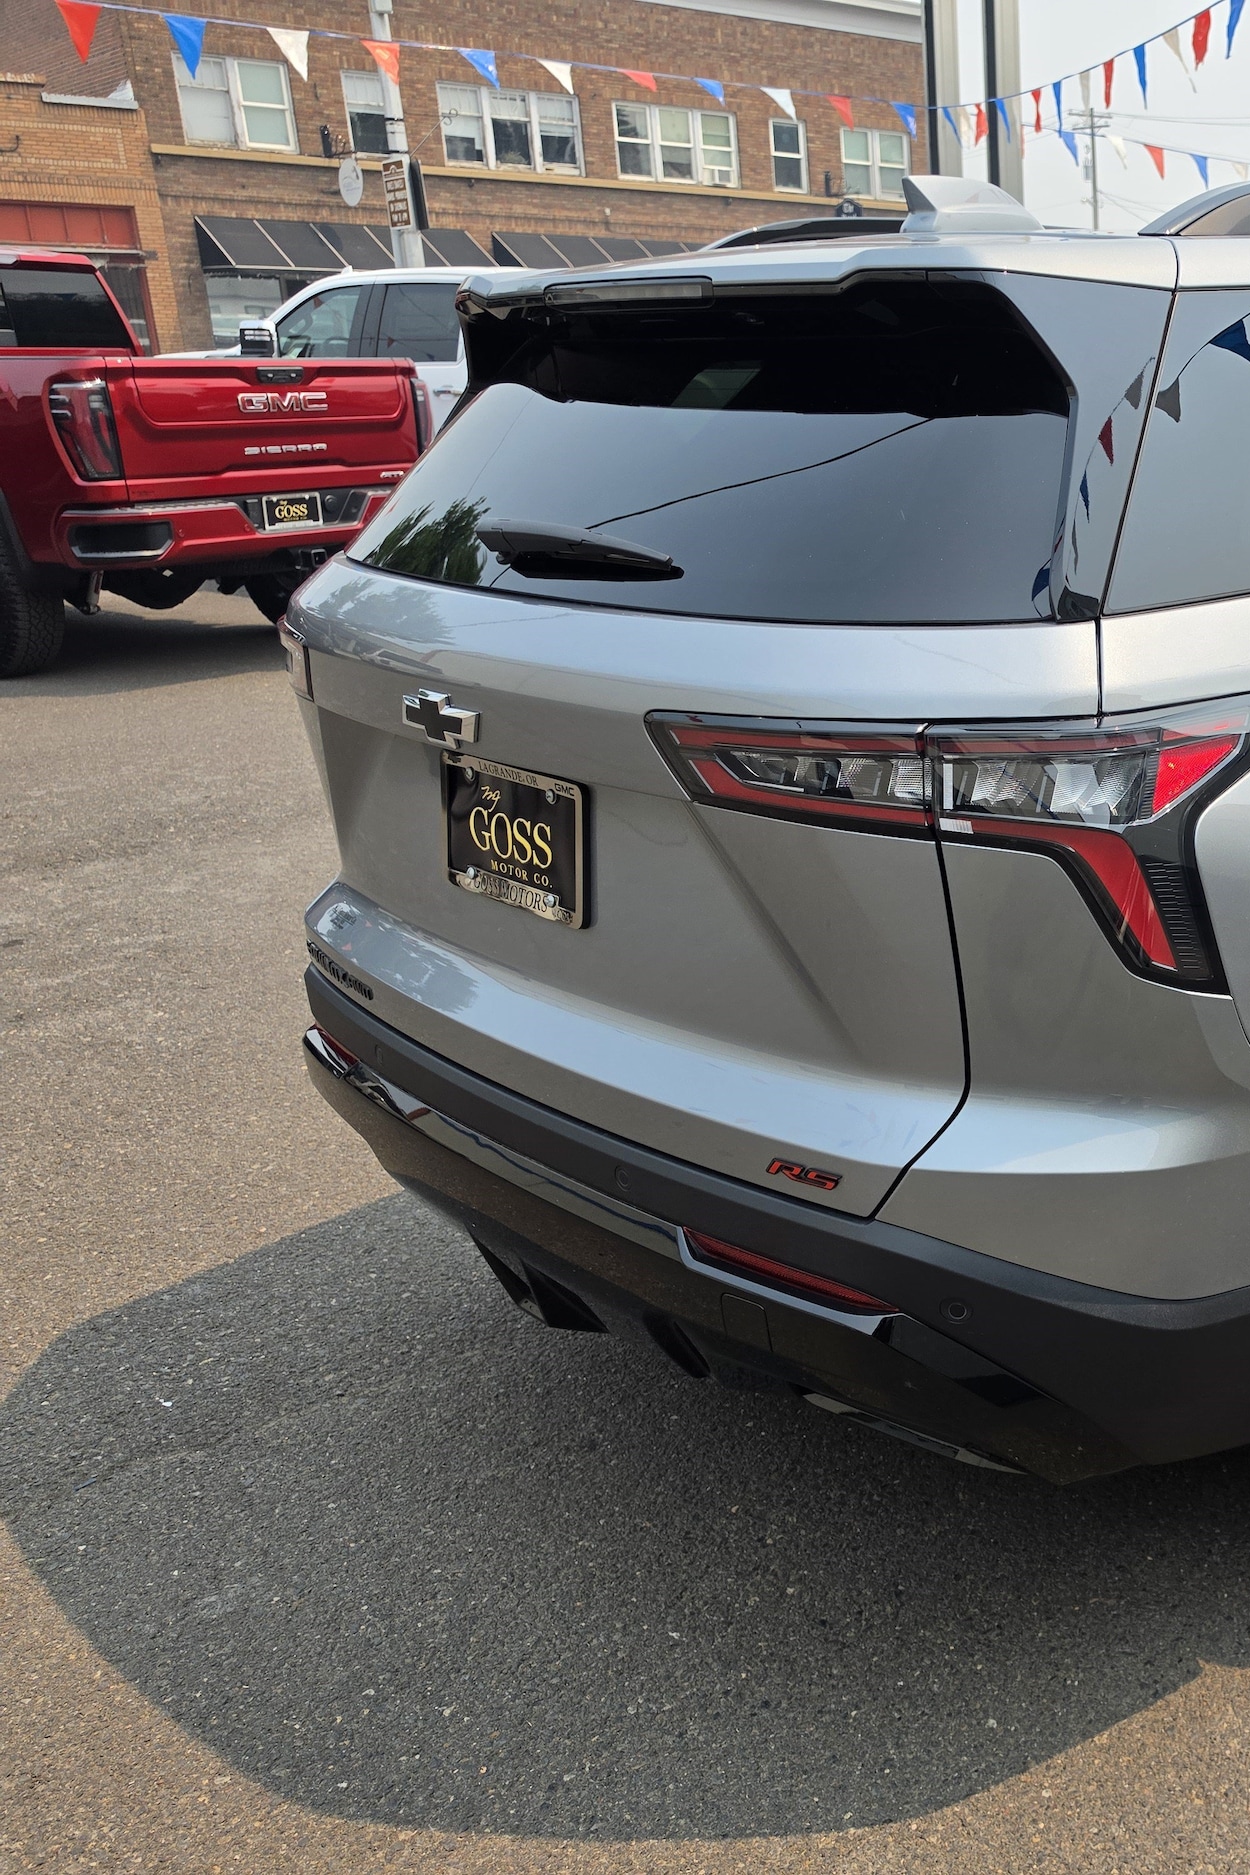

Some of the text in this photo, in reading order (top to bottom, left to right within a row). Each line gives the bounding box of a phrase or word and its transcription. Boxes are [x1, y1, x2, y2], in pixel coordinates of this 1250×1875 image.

[237, 391, 328, 413] GMC
[244, 442, 328, 456] SIERRA
[274, 503, 308, 519] GOSS
[525, 775, 539, 787] OR
[554, 783, 575, 797] GMC
[469, 806, 552, 869] GOSS
[490, 859, 553, 888] MOTOR CO.
[473, 873, 549, 913] GOSS MOTORS
[766, 1157, 843, 1191] RS
